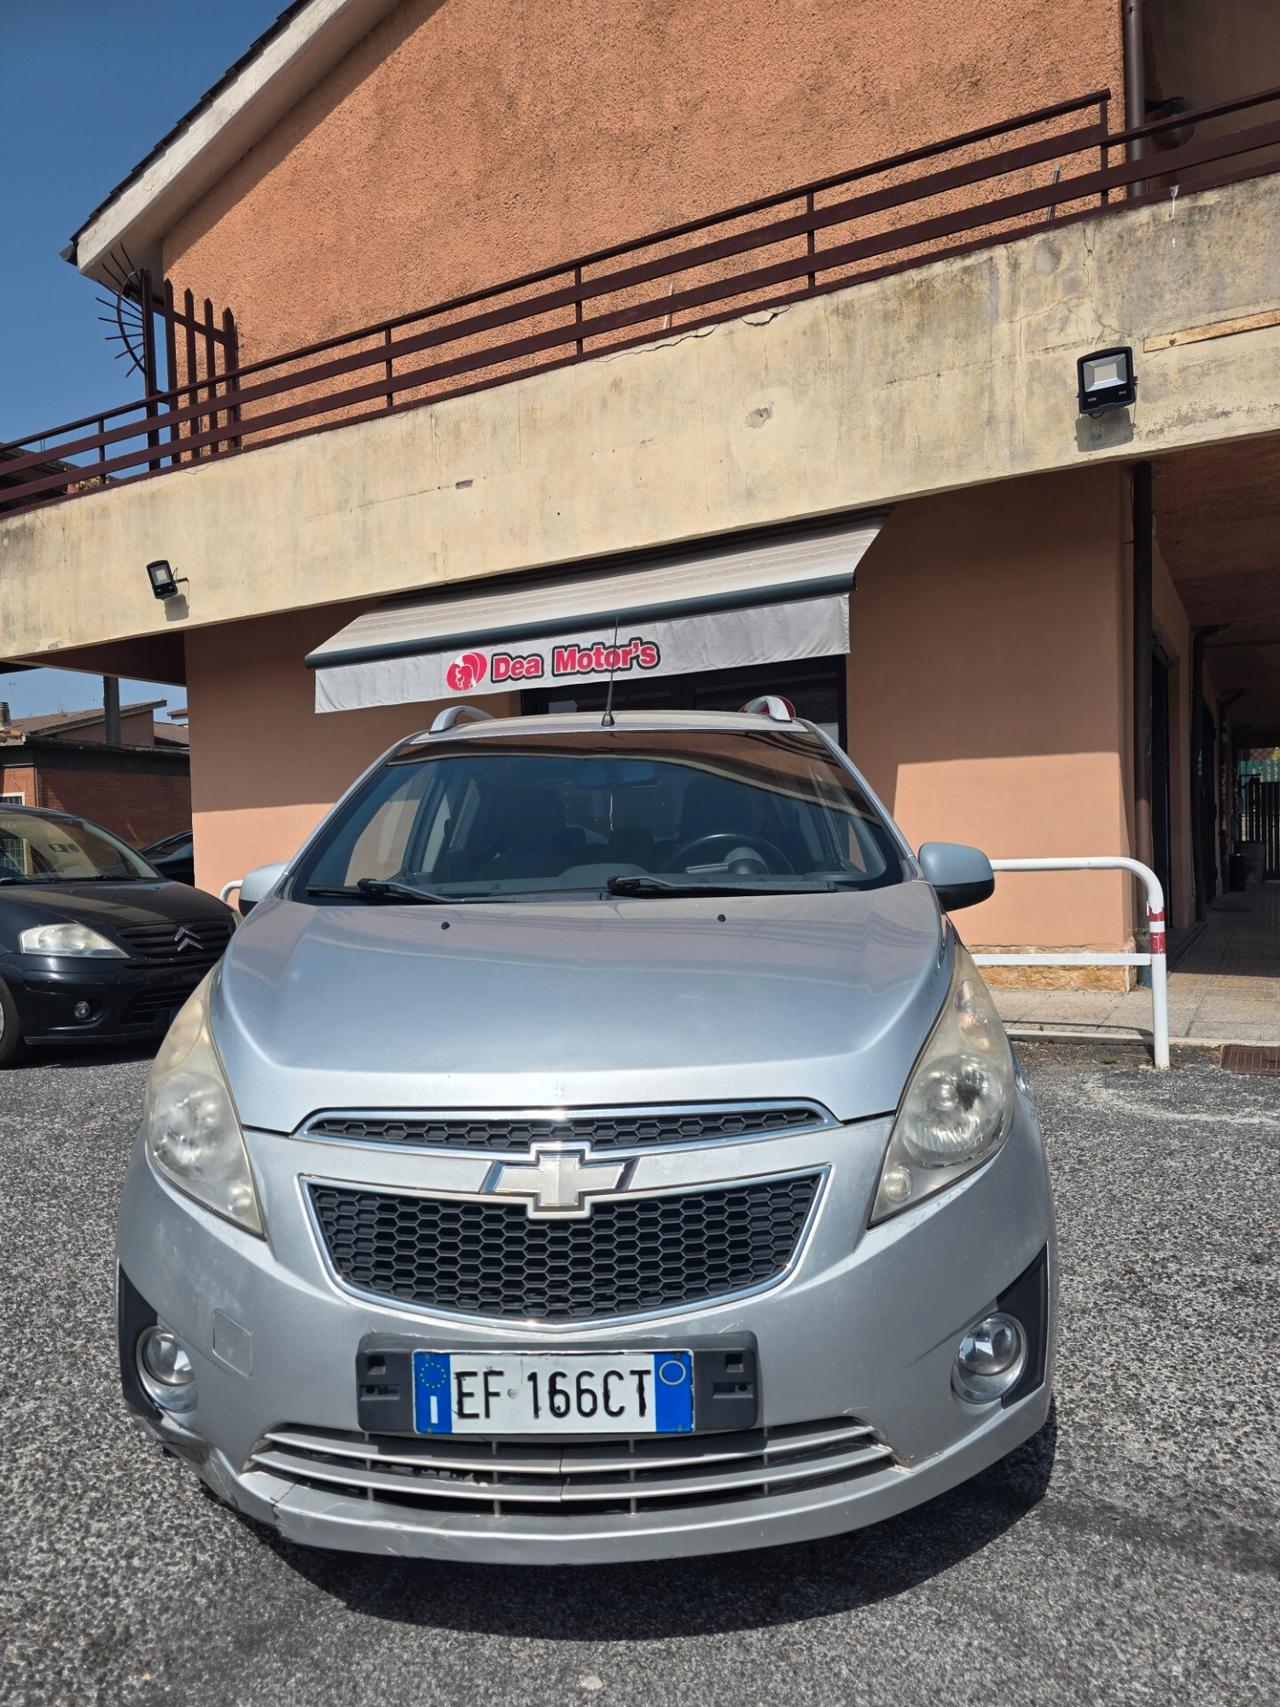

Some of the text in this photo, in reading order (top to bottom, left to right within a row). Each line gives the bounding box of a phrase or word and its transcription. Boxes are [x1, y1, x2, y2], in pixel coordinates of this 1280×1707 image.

[492, 638, 660, 682] Dea Motor's
[454, 1369, 652, 1419] EF 166CT
